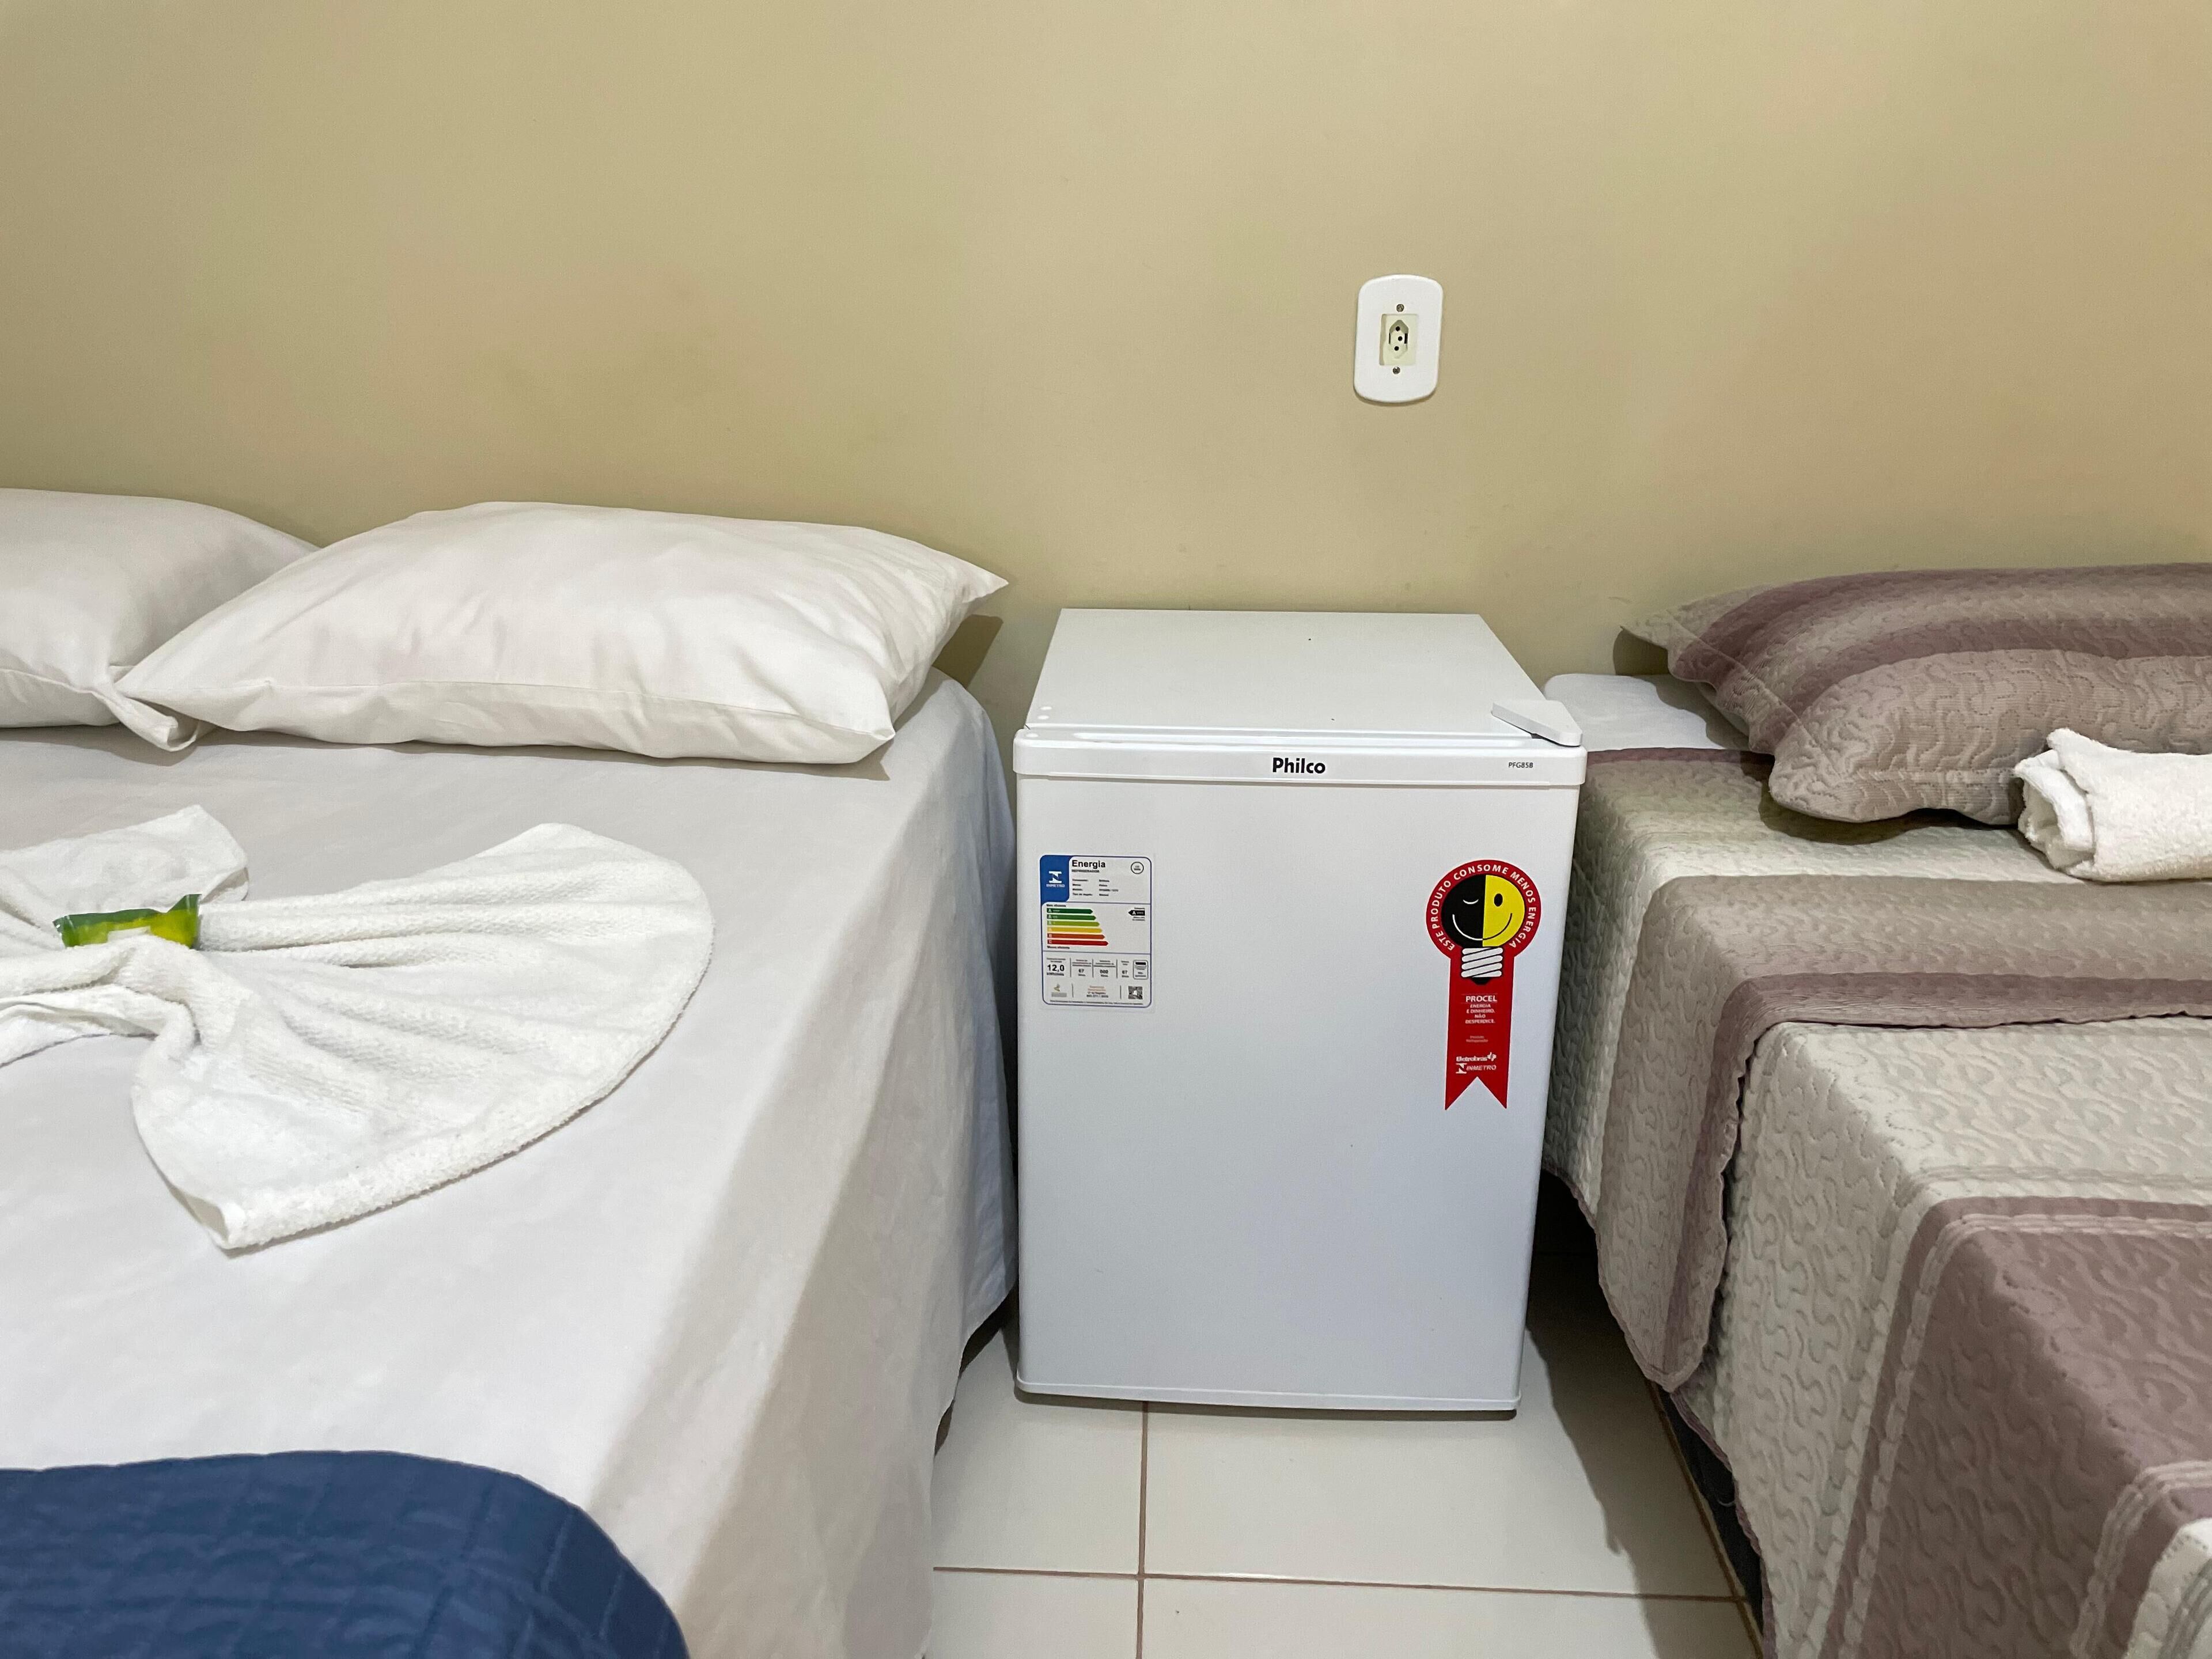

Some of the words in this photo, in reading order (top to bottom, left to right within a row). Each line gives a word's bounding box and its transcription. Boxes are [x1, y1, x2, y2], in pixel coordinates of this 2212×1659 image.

[1272, 757, 1326, 774] Philco
[1071, 859, 1106, 869] Energia
[1453, 864, 1509, 880] CONSOME
[1510, 872, 1536, 903] MENOS
[1430, 880, 1452, 929] PRODUTO
[1509, 907, 1536, 949] ENERGIA
[1435, 930, 1456, 951] ESTE
[1047, 964, 1065, 972] 12,0
